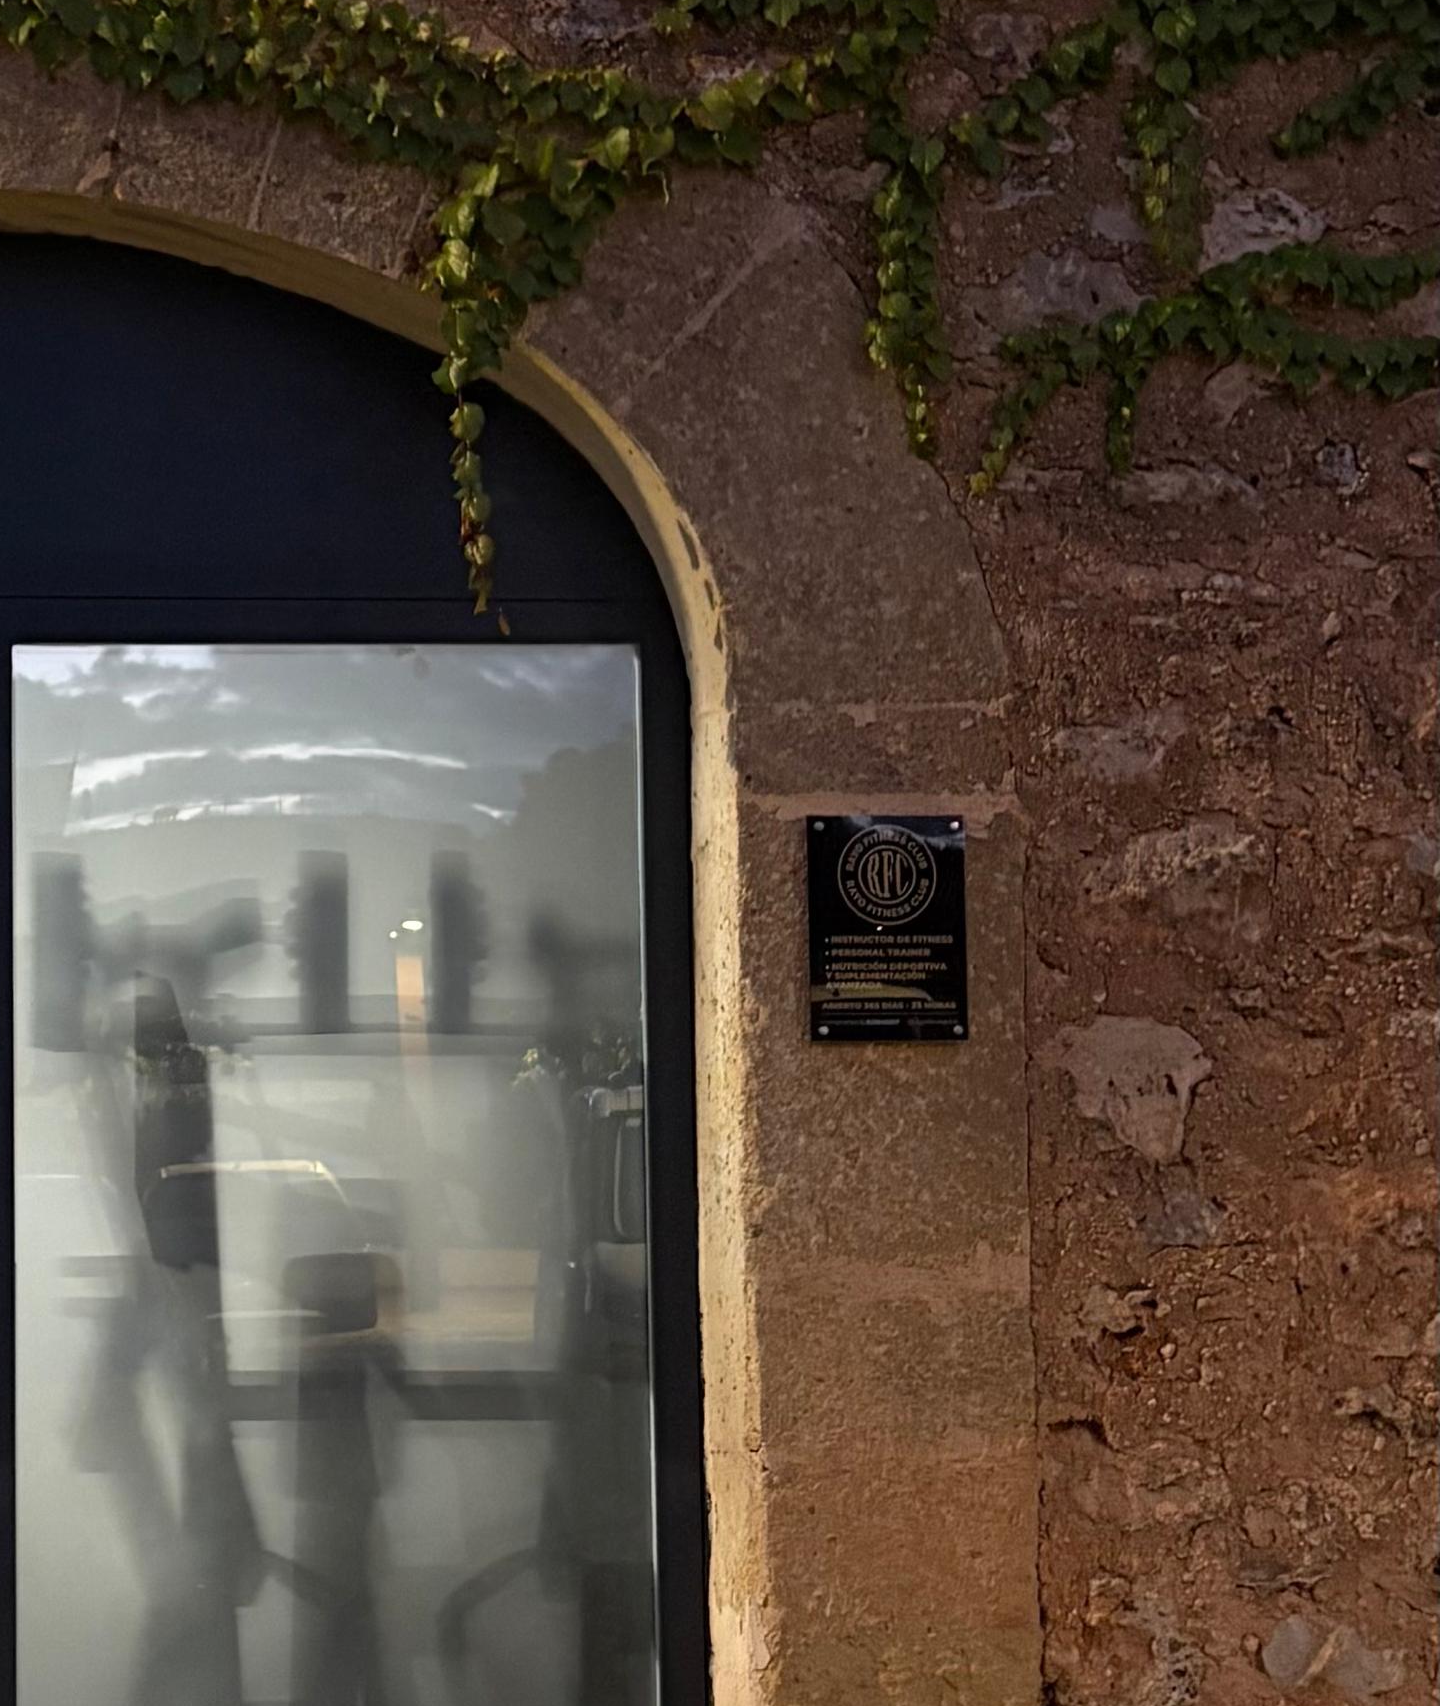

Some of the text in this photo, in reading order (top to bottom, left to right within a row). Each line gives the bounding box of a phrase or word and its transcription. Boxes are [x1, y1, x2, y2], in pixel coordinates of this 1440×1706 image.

[867, 850, 909, 899] RFC
[866, 903, 912, 918] FITNESS
[831, 935, 954, 944] INSTRUCTOR DE FITNESS
[831, 948, 931, 957] PERSONAL TRAINER
[831, 961, 948, 971] NUTRICIÓN DEPORTIVA
[834, 970, 926, 980] SUPLEMENTACIÓN
[825, 981, 883, 990] AVANZADA
